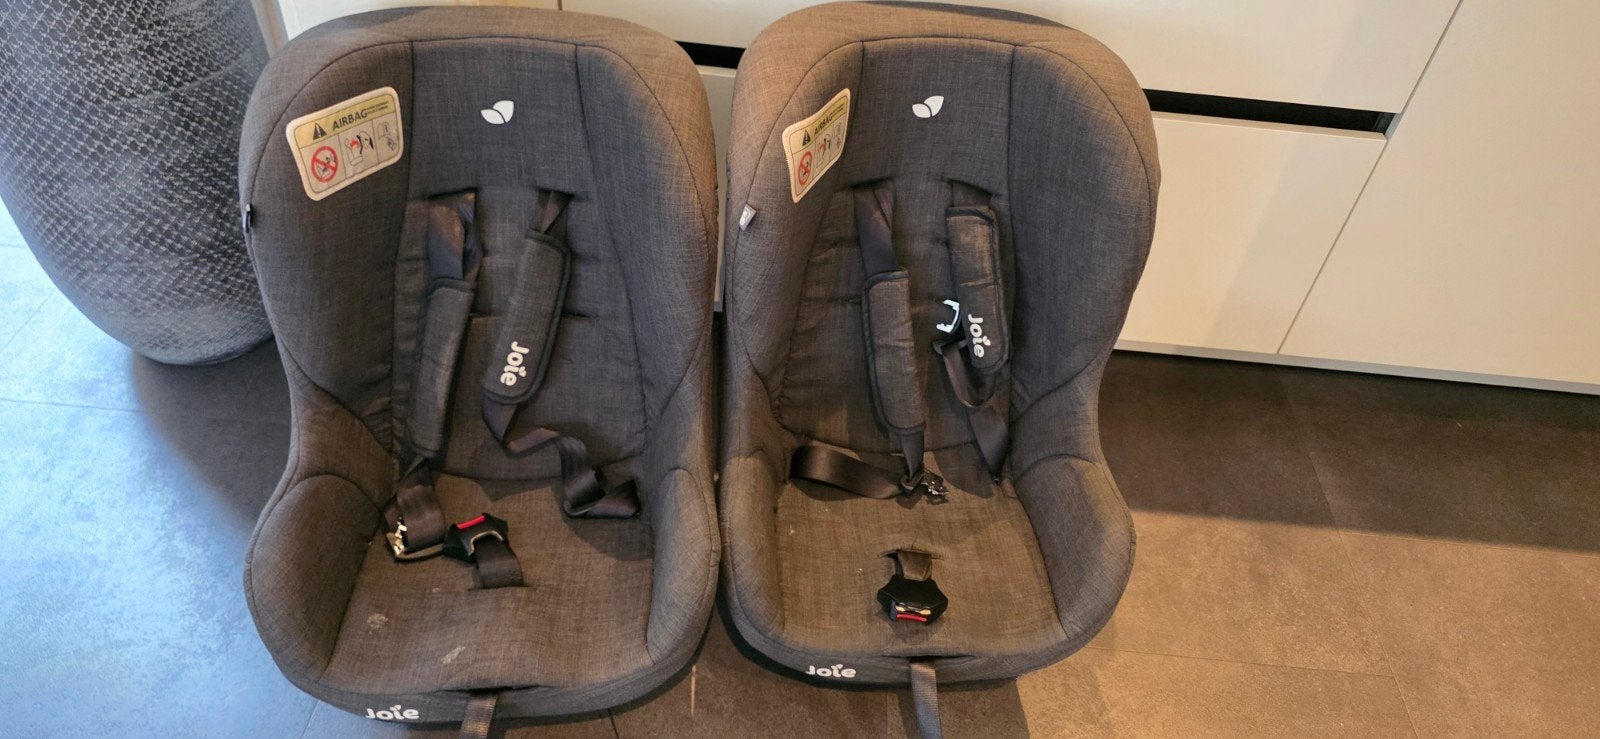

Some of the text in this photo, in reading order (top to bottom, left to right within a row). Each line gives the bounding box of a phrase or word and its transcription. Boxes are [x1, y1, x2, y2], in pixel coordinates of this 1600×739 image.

[332, 108, 368, 131] AIRBAG
[814, 115, 833, 137] AIRBAG
[968, 313, 991, 358] Joie
[500, 341, 530, 386] Joie
[805, 664, 857, 678] Joie
[365, 704, 420, 720] Joie
